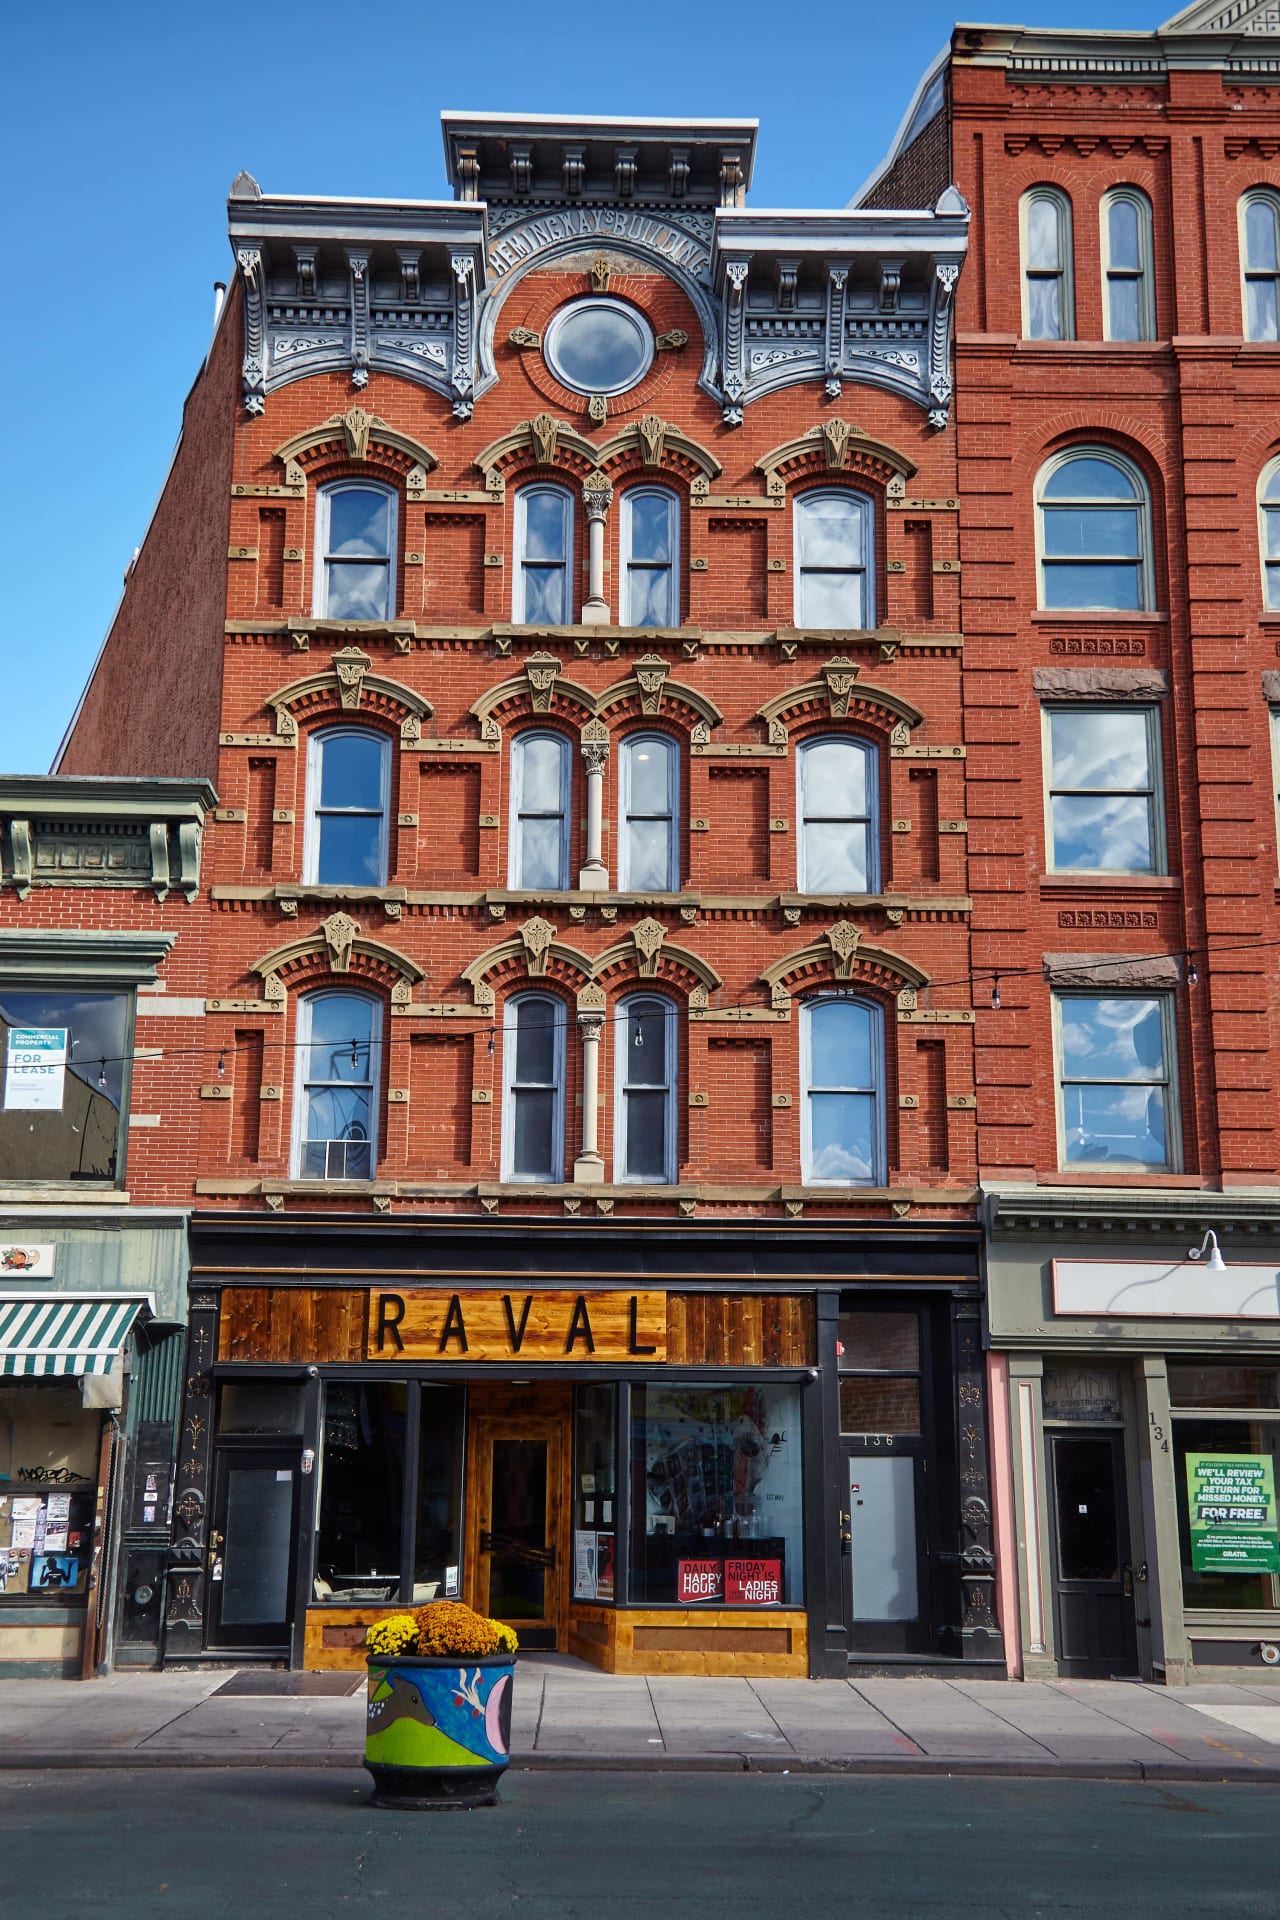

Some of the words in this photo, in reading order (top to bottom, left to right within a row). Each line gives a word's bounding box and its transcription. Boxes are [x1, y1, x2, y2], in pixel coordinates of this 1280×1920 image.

[613, 209, 708, 275] BUILDING
[14, 1054, 41, 1063] FOR
[13, 1065, 55, 1074] LEASE
[378, 1294, 657, 1354] RAVAL
[1149, 1412, 1169, 1452] 134
[864, 1434, 893, 1445] 136
[1198, 1469, 1225, 1477] WE'LL
[1227, 1469, 1263, 1478] REVIEW
[1198, 1494, 1231, 1502] MISSED
[1233, 1495, 1265, 1503] MONEY.
[1202, 1508, 1227, 1518] FOR
[1230, 1509, 1264, 1519] FREE.
[684, 1564, 716, 1573] DAILY
[728, 1562, 766, 1571] FRIDAY
[684, 1573, 722, 1583] HAPPY
[728, 1572, 760, 1581] NIGHT
[765, 1572, 774, 1581] IS
[683, 1583, 716, 1593] HOUR
[739, 1581, 778, 1590] LADIES
[745, 1590, 778, 1600] NIGHT
